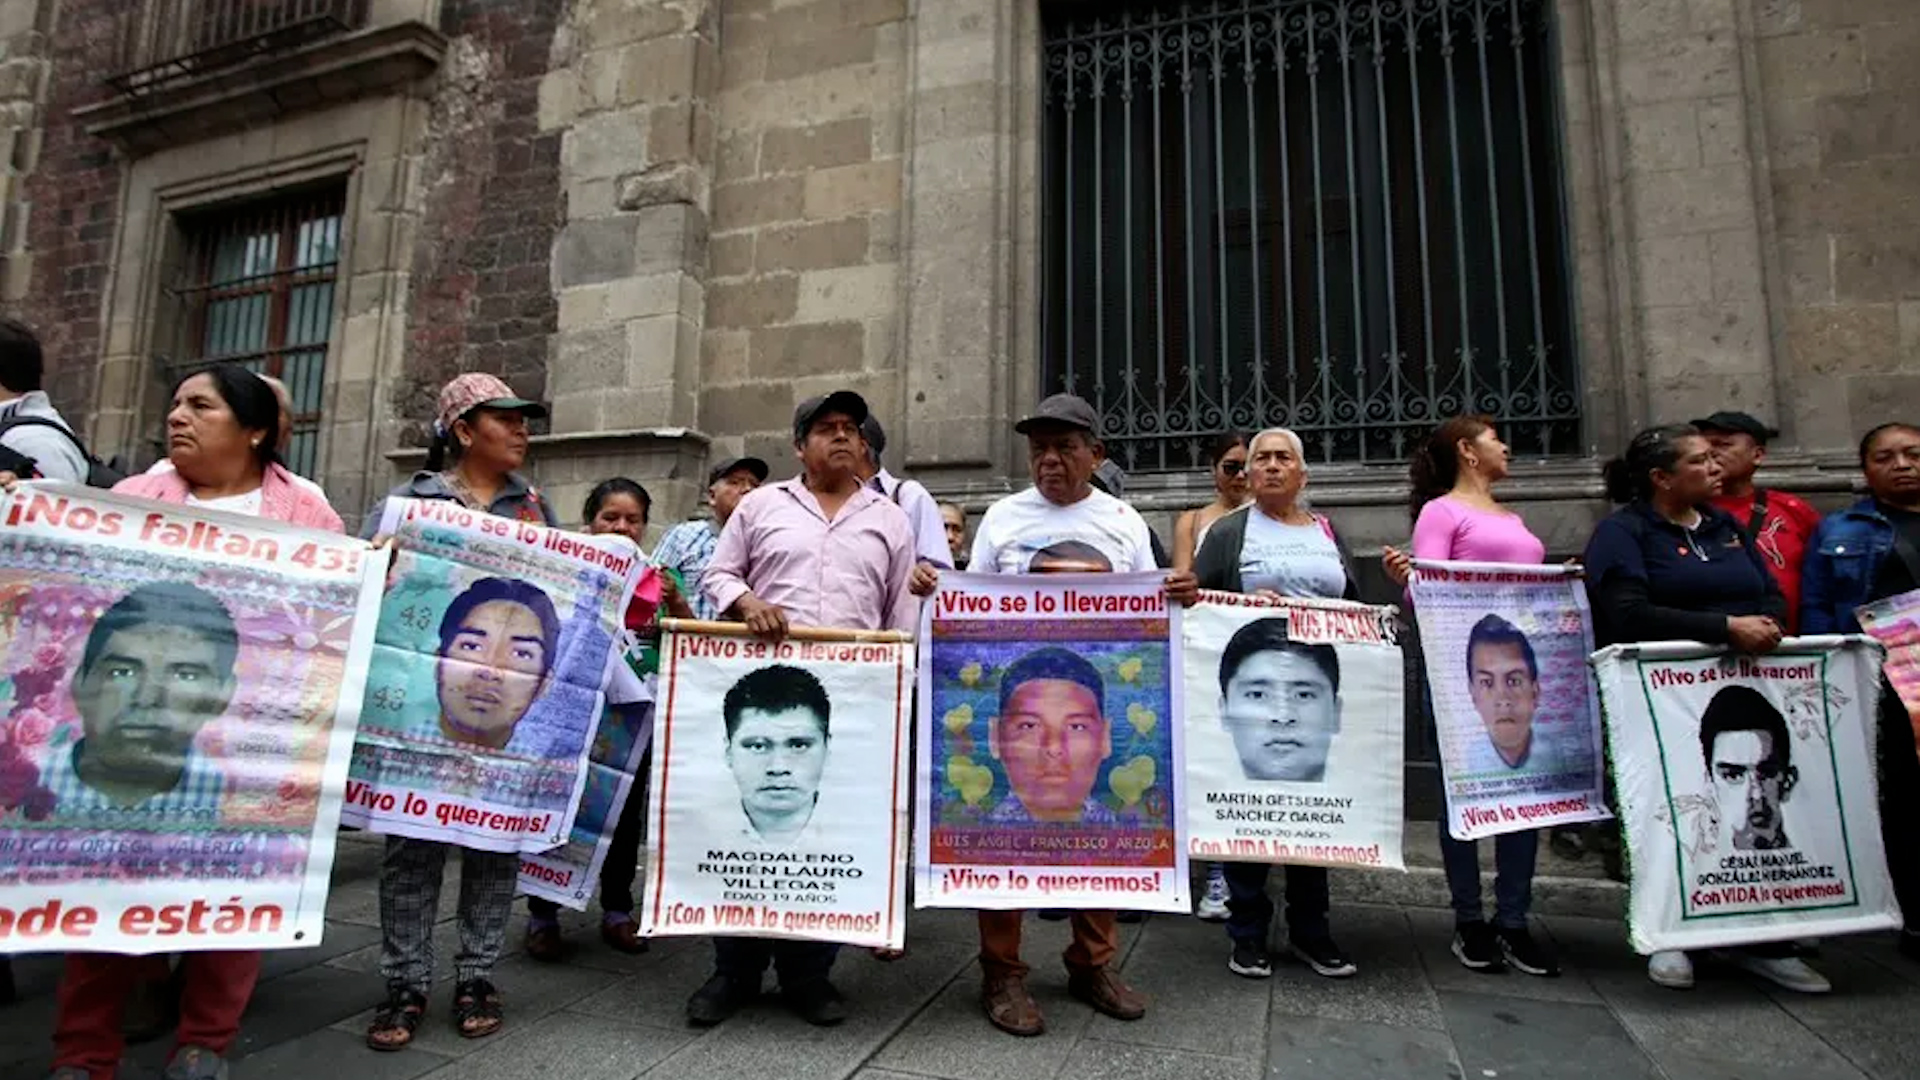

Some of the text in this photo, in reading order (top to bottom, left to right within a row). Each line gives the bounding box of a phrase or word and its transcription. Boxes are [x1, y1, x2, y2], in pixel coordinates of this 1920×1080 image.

[5, 494, 359, 573] ¡Nos faltan 43!
[481, 518, 509, 536] se
[516, 523, 538, 544] lo
[545, 529, 631, 576] llevaron!
[935, 590, 1164, 617] ¡Vivo se lo llevaron!
[1289, 606, 1321, 637] NOS
[680, 636, 894, 663] ¡Vivo se lo llevaron!
[1650, 668, 1694, 689] ¡Vivo
[1700, 668, 1717, 683] se
[1739, 658, 1816, 680] llevaron!
[403, 792, 428, 816] lo
[1266, 794, 1353, 808] GETSEMANY
[1462, 793, 1590, 831] ¡Vivo lo queremos!
[1215, 807, 1345, 824] SÁNCHEZ GARCÍA
[936, 835, 970, 848] LUIS
[1031, 837, 1107, 849] FRANCISCO
[1235, 827, 1272, 837] EDAD
[1276, 829, 1291, 838] 20
[0, 837, 69, 853] RICIO
[706, 849, 855, 864] MAGDALENO
[1227, 839, 1268, 858] VIDA
[698, 863, 863, 879] RUBÉN LAURO
[943, 868, 1160, 895] ¡Vivo lo queremos!
[723, 878, 836, 892] VILLEGAS
[723, 890, 838, 904] EDAD 19 AÑOS
[1721, 886, 1759, 904] VIDA
[1772, 879, 1846, 903] queremos!
[118, 896, 283, 935] están
[665, 902, 881, 933] ¡Con VIDA lo queremos!
